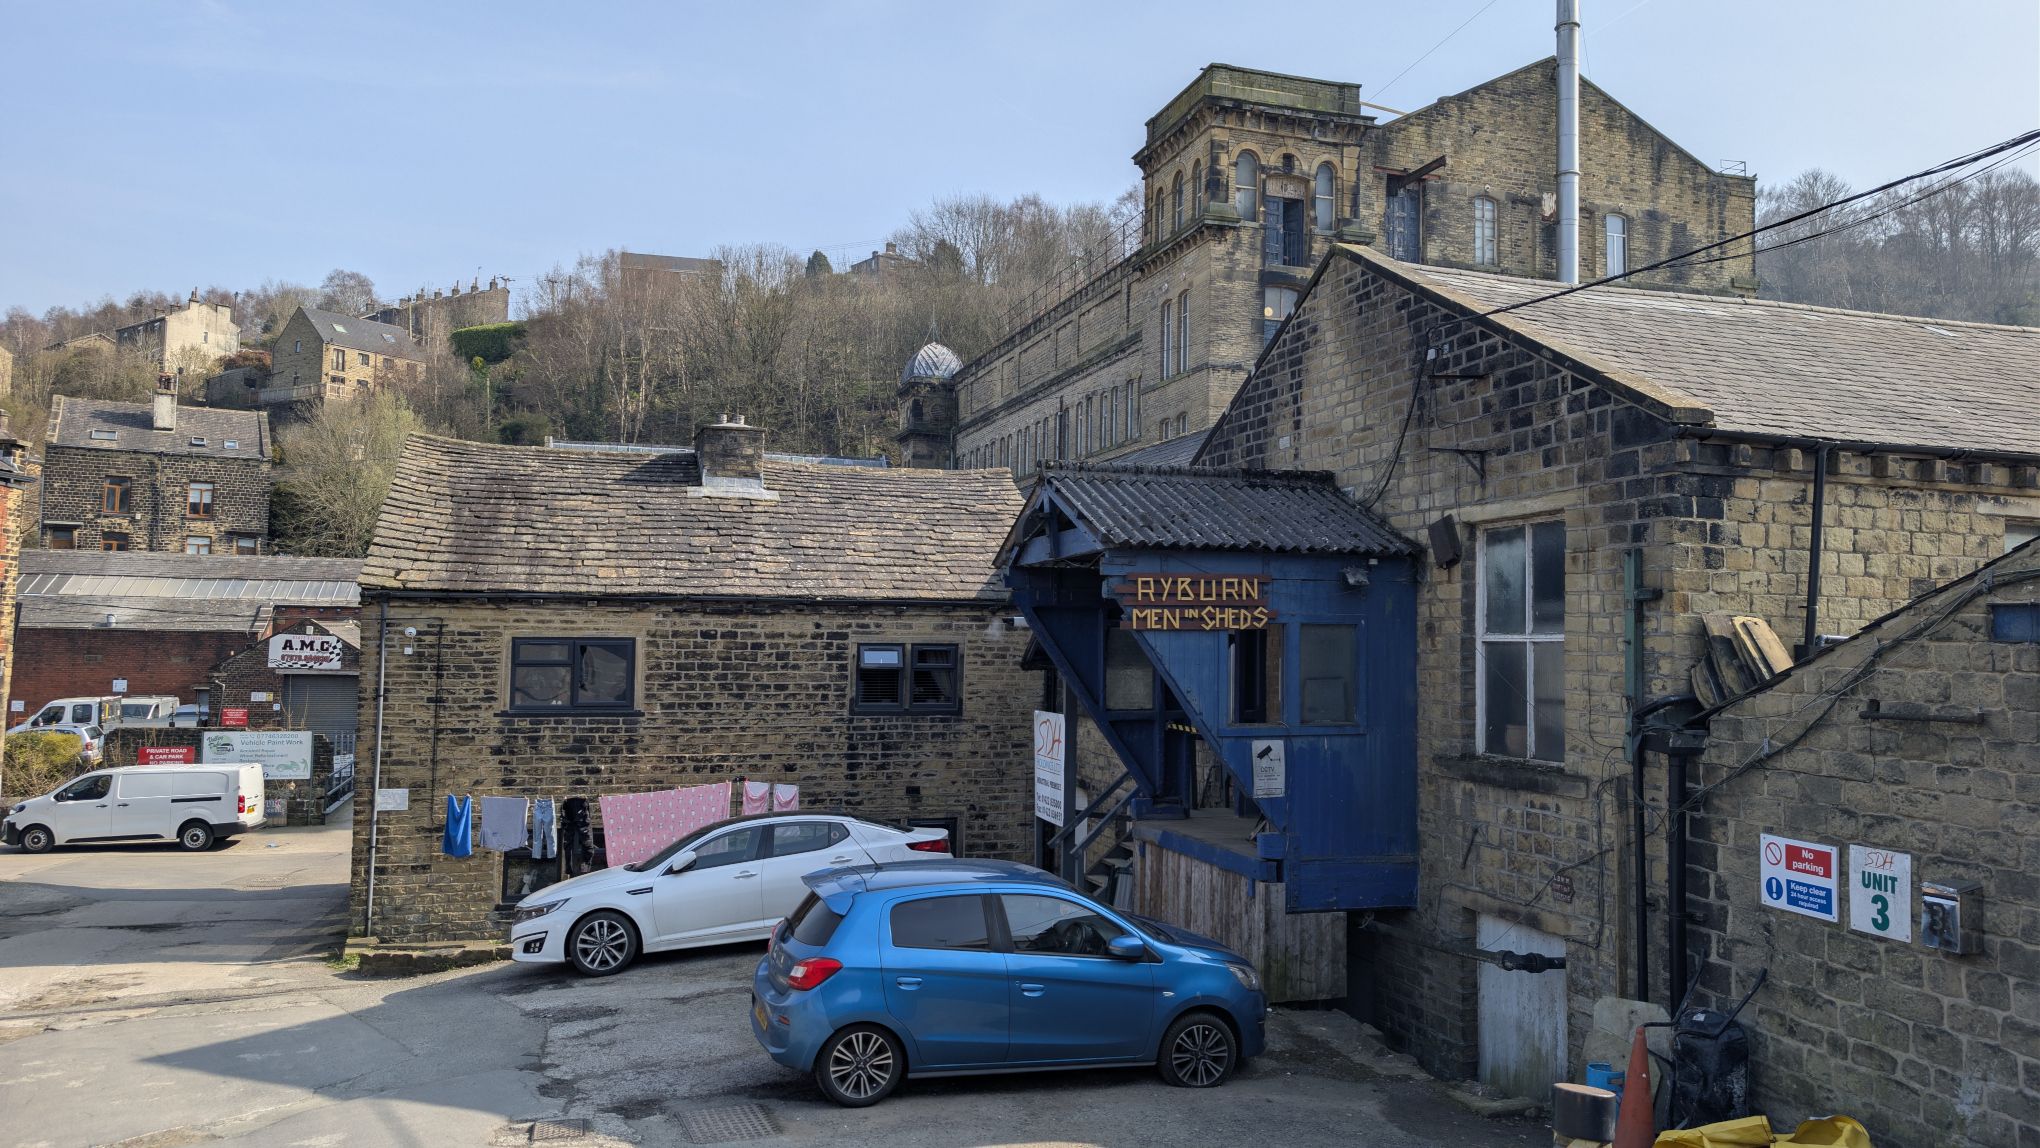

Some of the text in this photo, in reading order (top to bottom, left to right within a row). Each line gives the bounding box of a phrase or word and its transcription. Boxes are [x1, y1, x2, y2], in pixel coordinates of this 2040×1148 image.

[1138, 577, 1258, 601] RYBURN
[1132, 605, 1269, 630] MEN IN SHEDS
[1801, 850, 1814, 860] No
[1792, 861, 1824, 875] parking
[1790, 882, 1827, 897] Keep clear
[1861, 870, 1898, 894] UNIT
[1798, 900, 1819, 910] required
[1799, 893, 1809, 901] hour
[1809, 897, 1827, 905] access
[1871, 894, 1890, 931] 3
